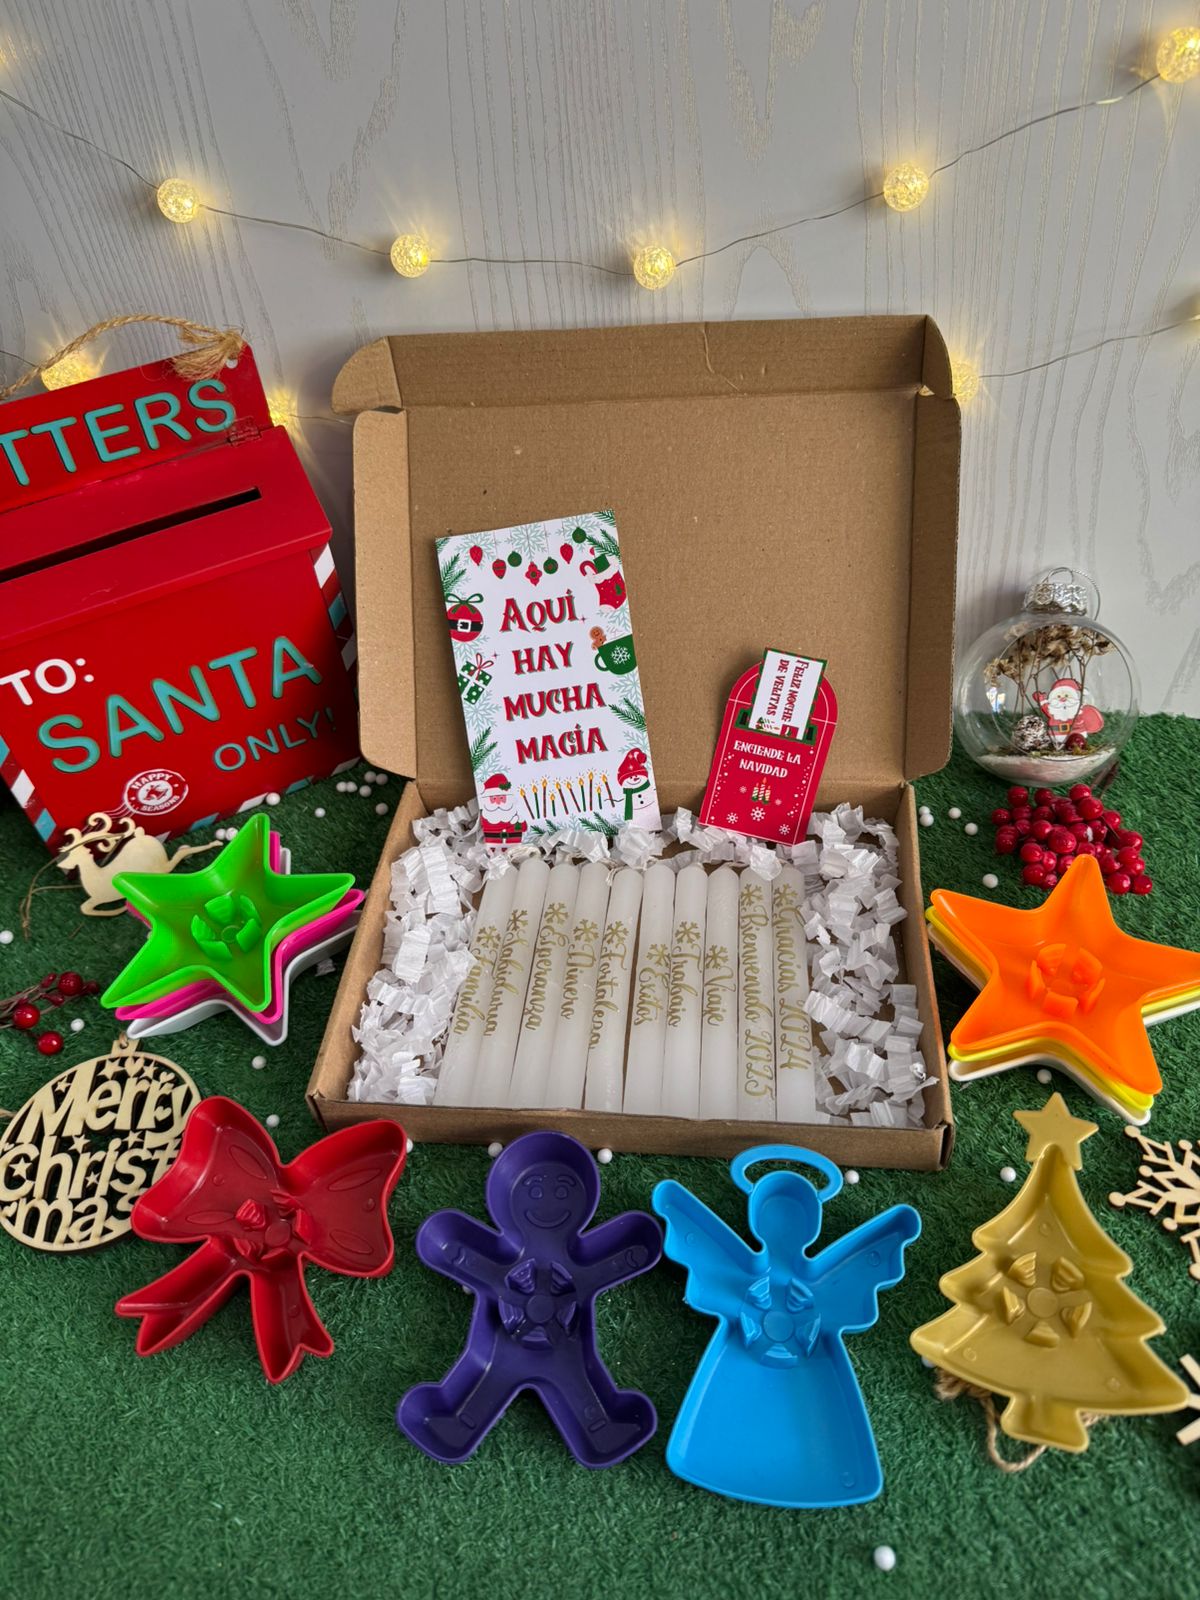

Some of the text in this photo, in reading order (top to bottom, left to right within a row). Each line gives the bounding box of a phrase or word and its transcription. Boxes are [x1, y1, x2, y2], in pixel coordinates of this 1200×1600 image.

[499, 588, 579, 633] AQUÍ
[0, 658, 94, 706] TO:
[512, 641, 573, 675] HAY
[766, 658, 790, 717] DE VELITAS
[38, 636, 322, 773] SANTA
[503, 682, 606, 722] MUCHA
[781, 659, 809, 723] FELIZ NOCHE
[213, 706, 337, 771] ONLY!
[733, 740, 801, 765] ENCIENDE LA
[739, 759, 788, 778] NAVIDAD
[131, 772, 173, 790] HAPPY
[523, 925, 570, 1031] Esperanza
[560, 943, 597, 1020] Dinero
[668, 944, 703, 1028] Trabajo
[702, 966, 737, 1027] Viaje
[740, 904, 775, 1101] Bienvenido 2025
[771, 903, 813, 1071] Gracias 2024
[16, 1061, 196, 1149] Merry
